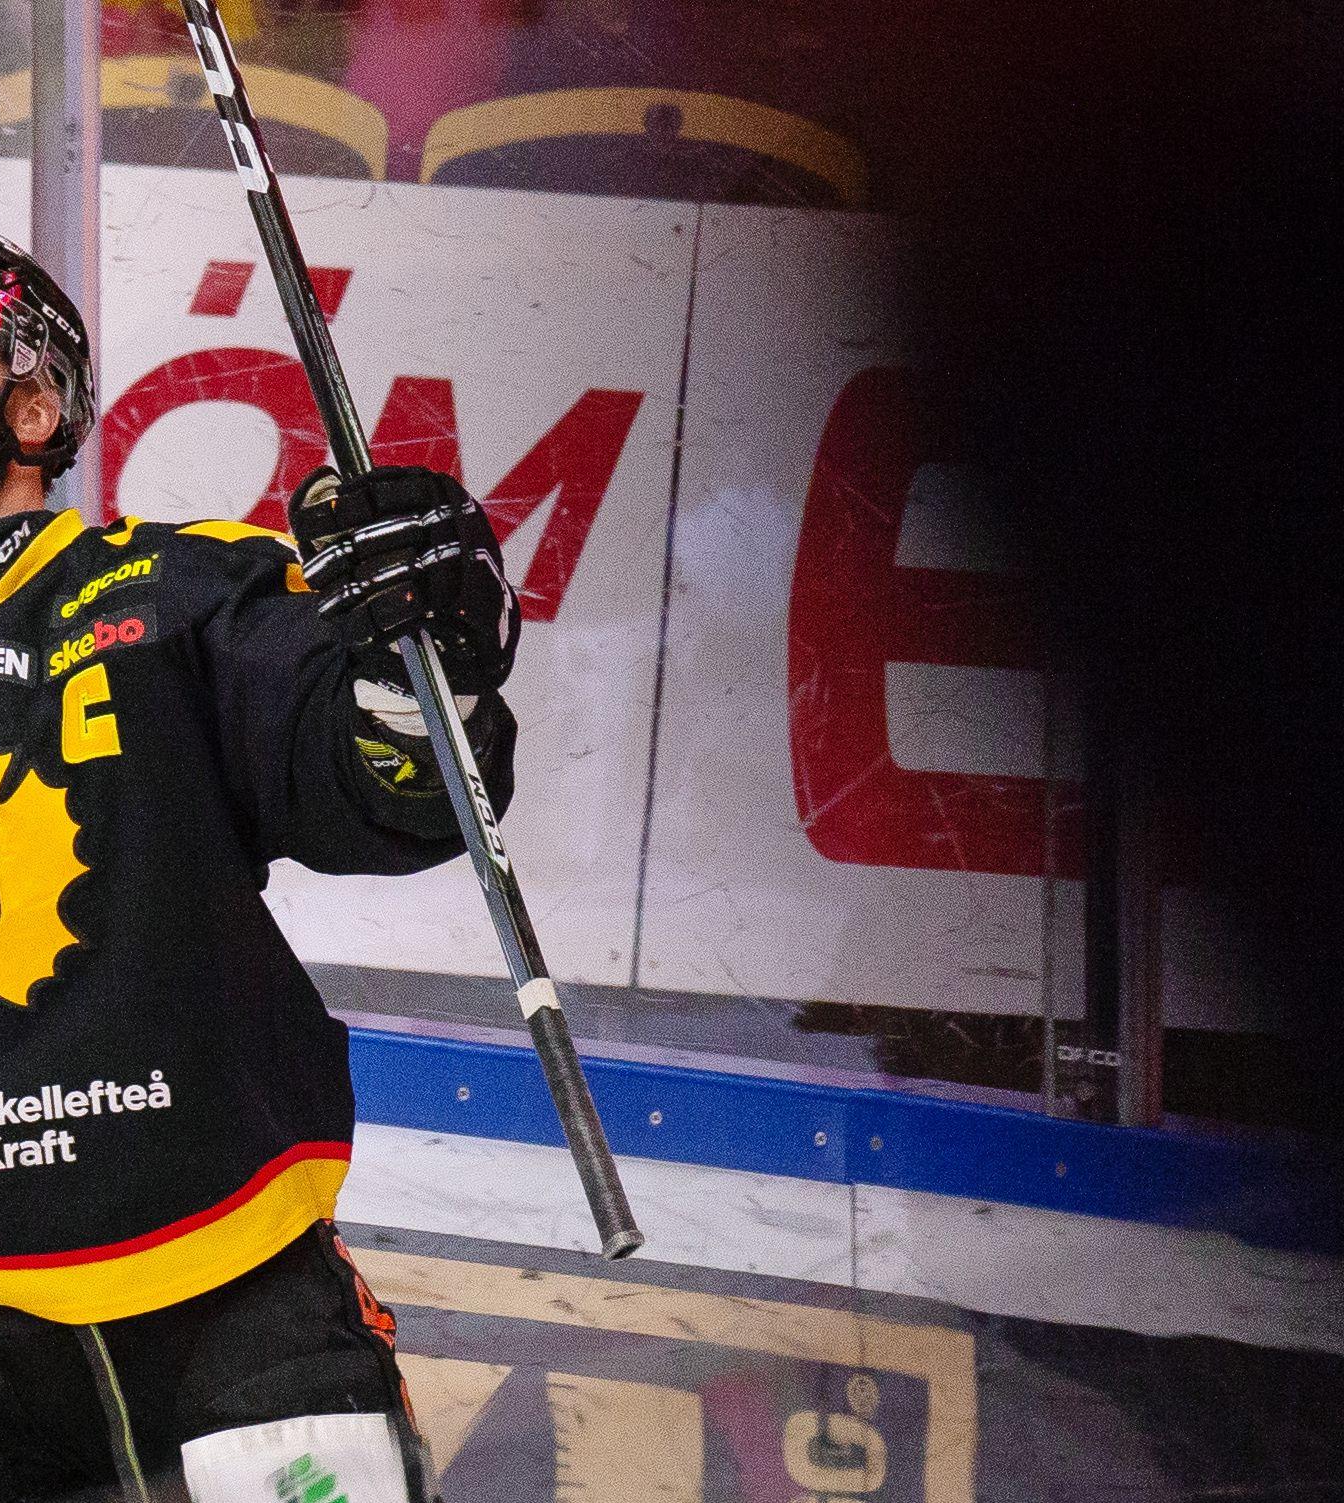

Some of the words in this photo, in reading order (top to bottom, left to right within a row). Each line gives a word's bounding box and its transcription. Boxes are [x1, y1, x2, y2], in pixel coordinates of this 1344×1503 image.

[49, 618, 146, 677] skebo
[61, 662, 123, 765] C
[467, 771, 507, 860] CCM
